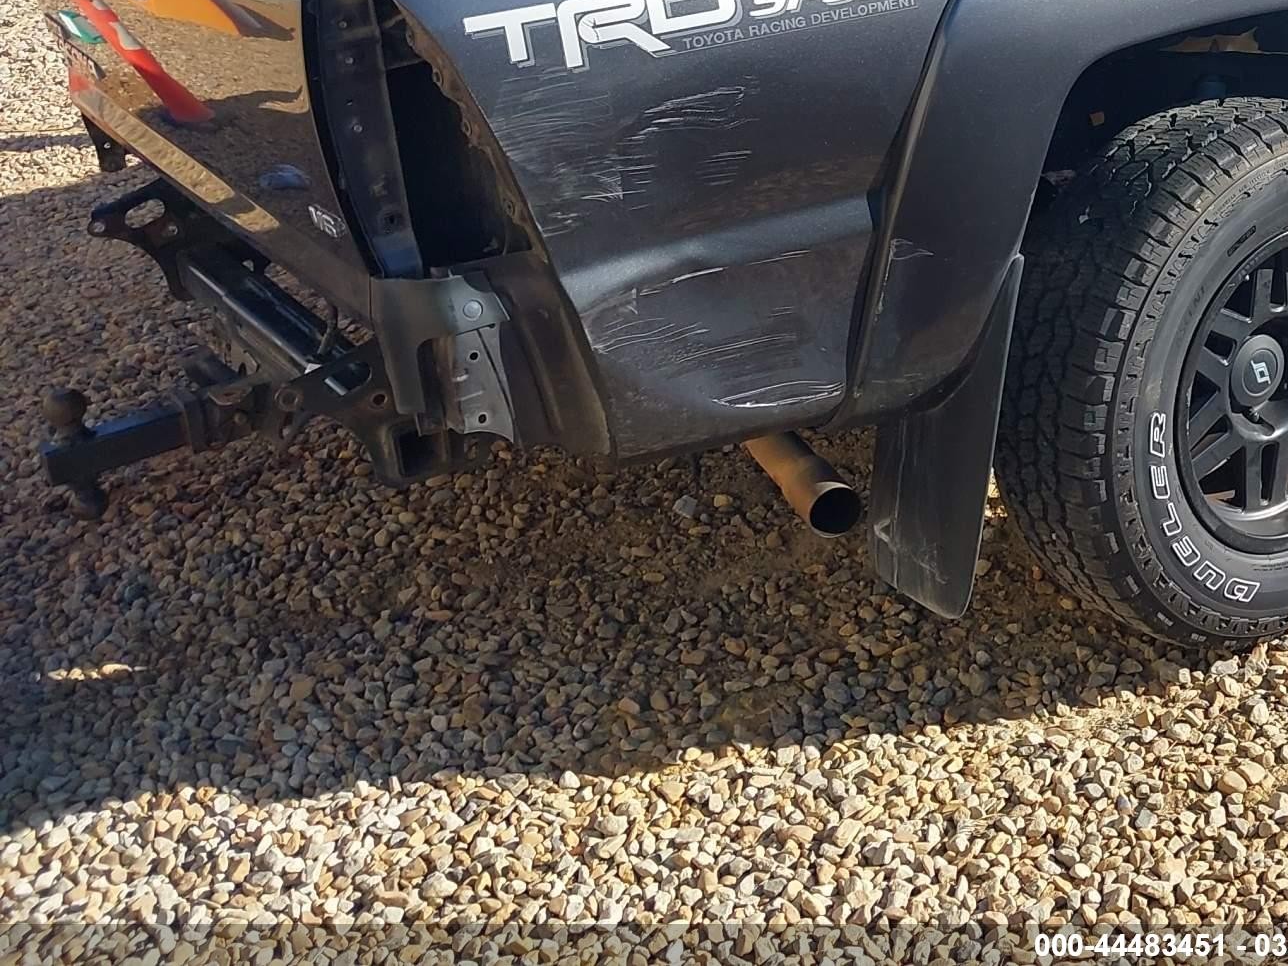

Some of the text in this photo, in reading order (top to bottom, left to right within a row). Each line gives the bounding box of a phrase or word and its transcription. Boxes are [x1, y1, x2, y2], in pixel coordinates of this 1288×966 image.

[683, 28, 745, 50] TOYOTA
[749, 16, 807, 37] RACING
[1149, 411, 1261, 603] DUELER
